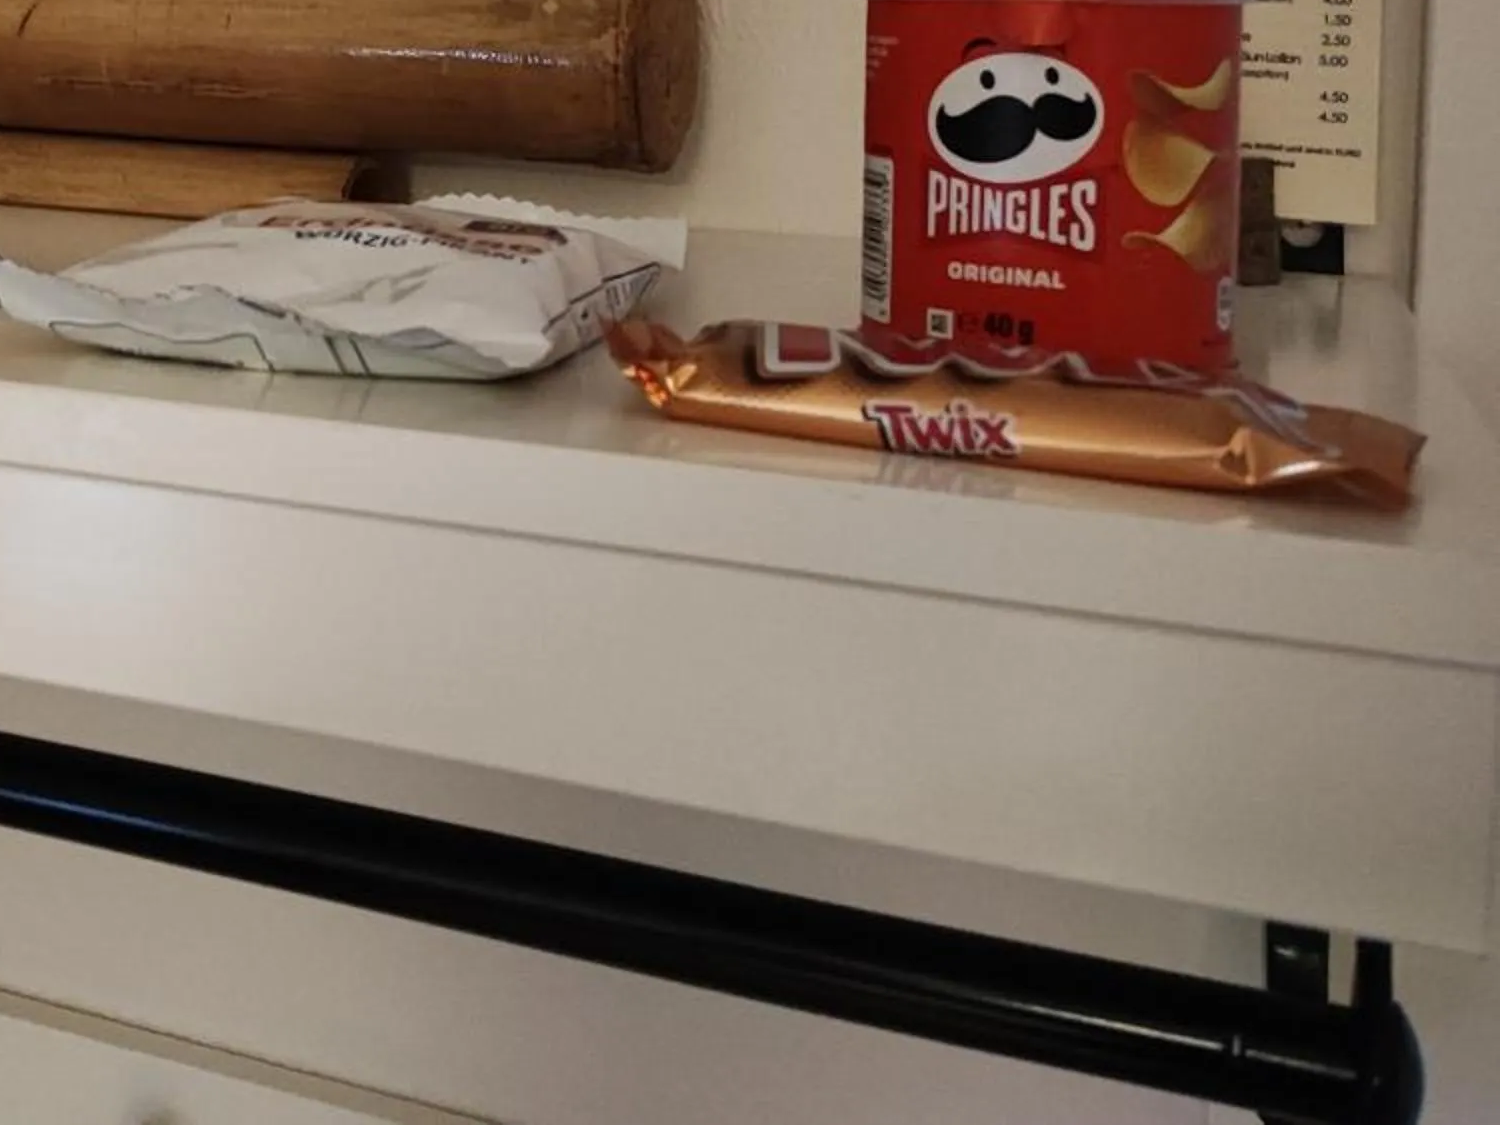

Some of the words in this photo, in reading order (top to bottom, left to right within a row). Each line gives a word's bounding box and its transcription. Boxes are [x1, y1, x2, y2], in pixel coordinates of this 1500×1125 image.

[927, 169, 1097, 252] PRINGLES
[947, 261, 1067, 290] ORIGINAL
[863, 398, 1023, 458] Twix
